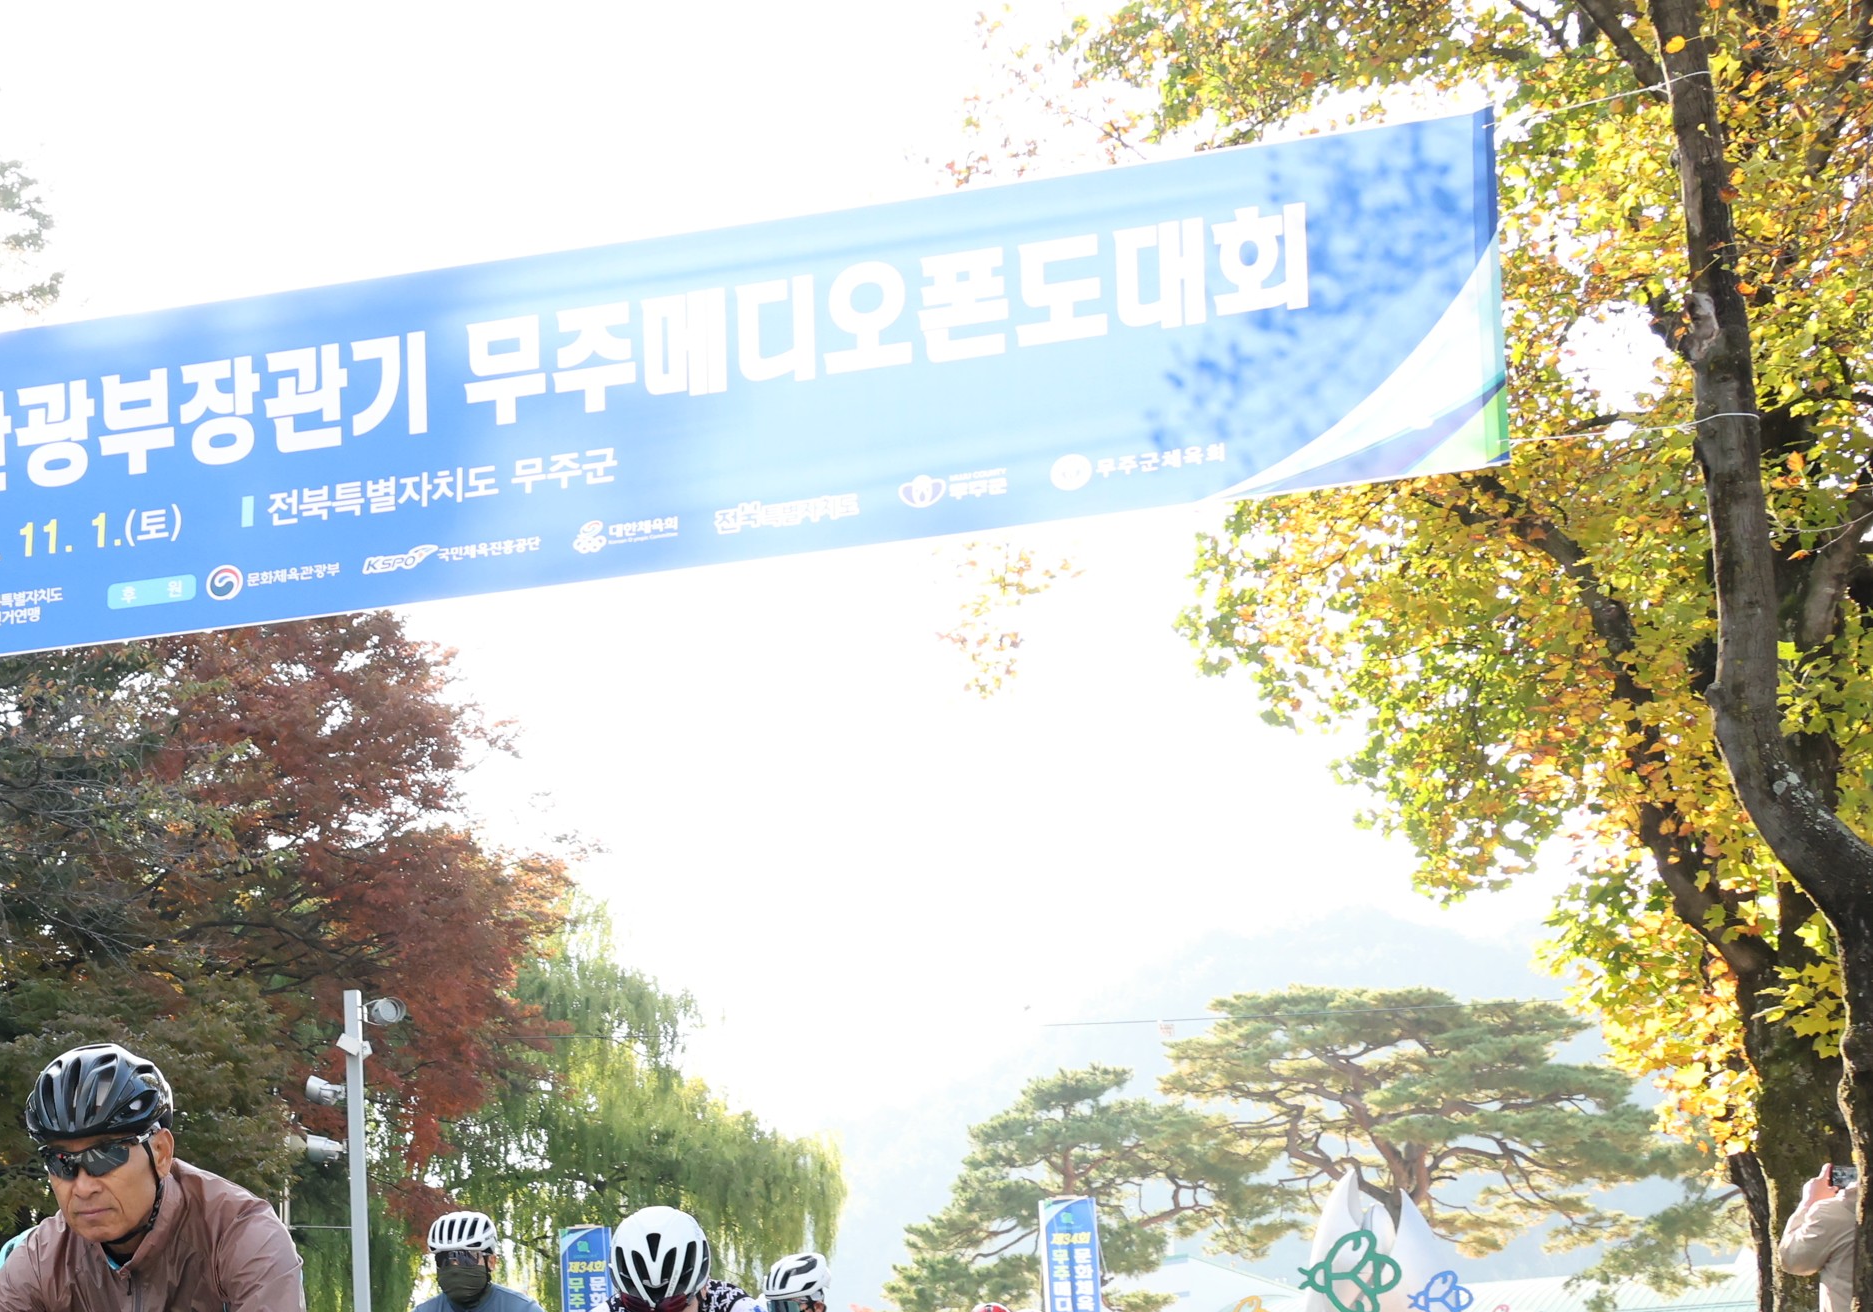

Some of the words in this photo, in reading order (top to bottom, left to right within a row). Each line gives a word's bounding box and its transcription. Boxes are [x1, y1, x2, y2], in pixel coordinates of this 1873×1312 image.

[463, 201, 1309, 426] 무주메디오폰도대회
[1095, 442, 1226, 479] 무주군체육회
[267, 465, 500, 526] 전북특별자치도
[511, 447, 618, 494] 무주군
[608, 515, 679, 538] 대한체육회
[436, 536, 542, 562] 국민체육진흥공단
[246, 562, 340, 588] 문화체육관광부
[364, 554, 418, 573] KSPO
[567, 1260, 606, 1273] 제34회
